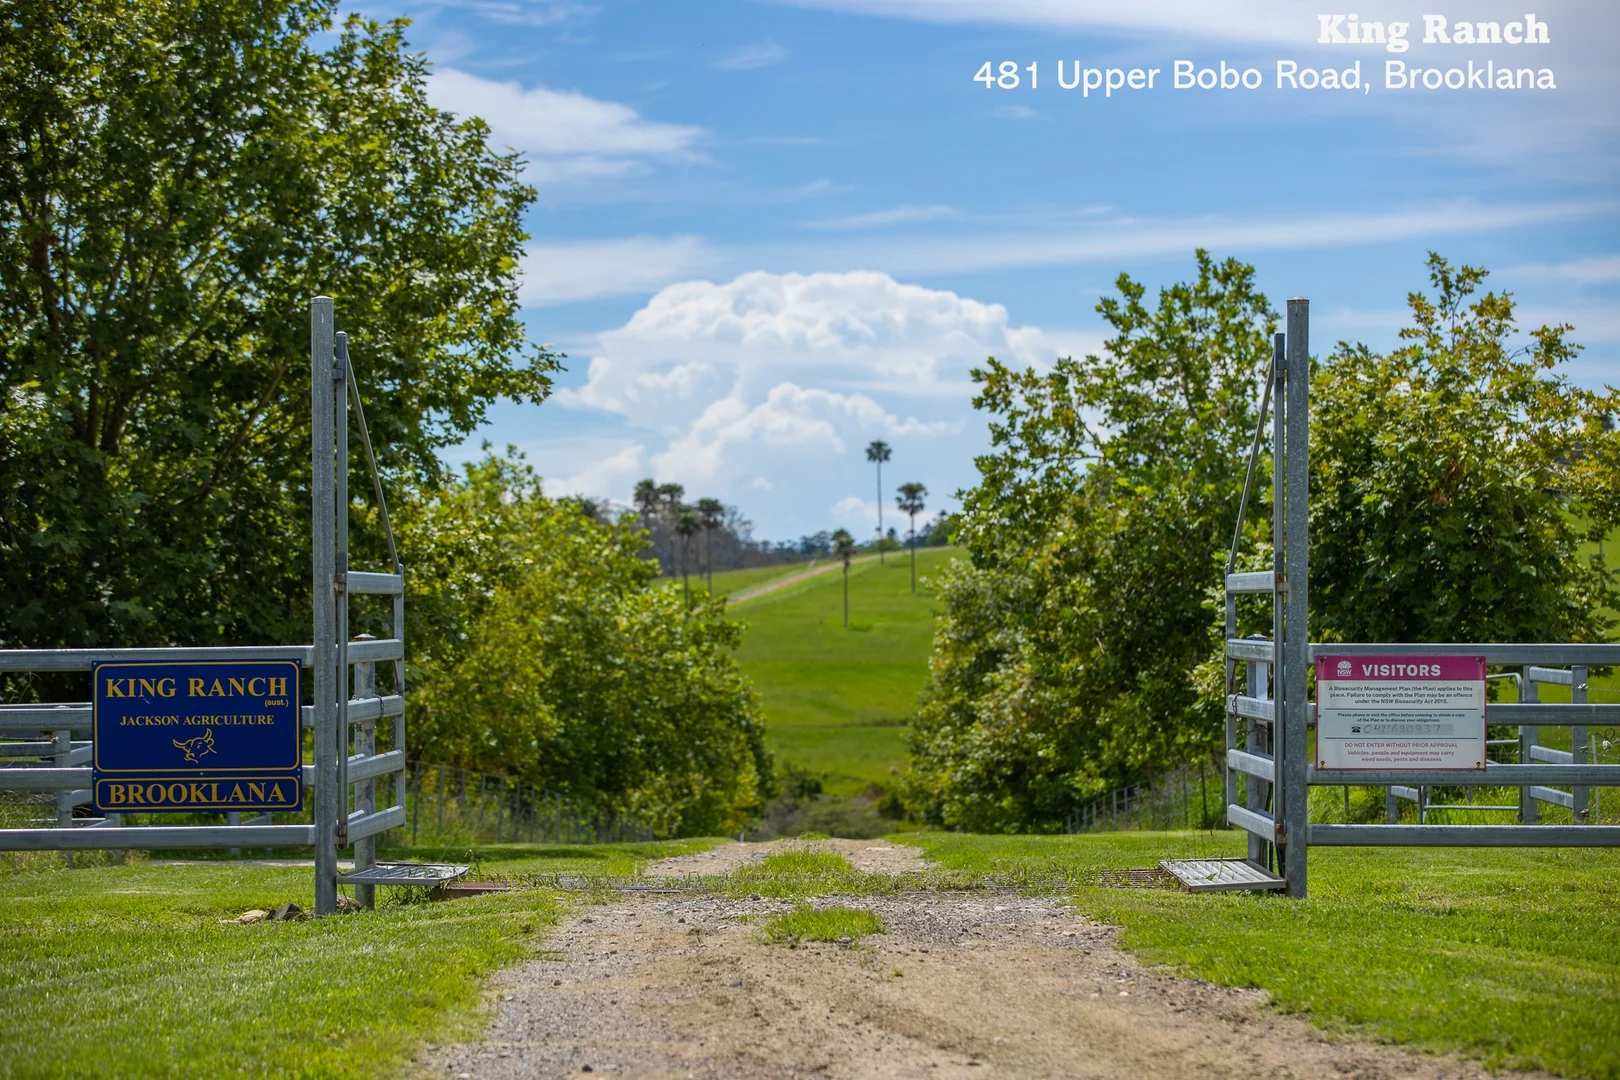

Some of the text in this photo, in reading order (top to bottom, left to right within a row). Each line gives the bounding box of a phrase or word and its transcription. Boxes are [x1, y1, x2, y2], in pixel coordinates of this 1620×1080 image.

[1362, 664, 1441, 676] VISITORS
[106, 677, 288, 698] KING RANCH
[120, 715, 274, 726] JACKSON AGRICULTURE
[109, 783, 286, 804] BROOKLANA
